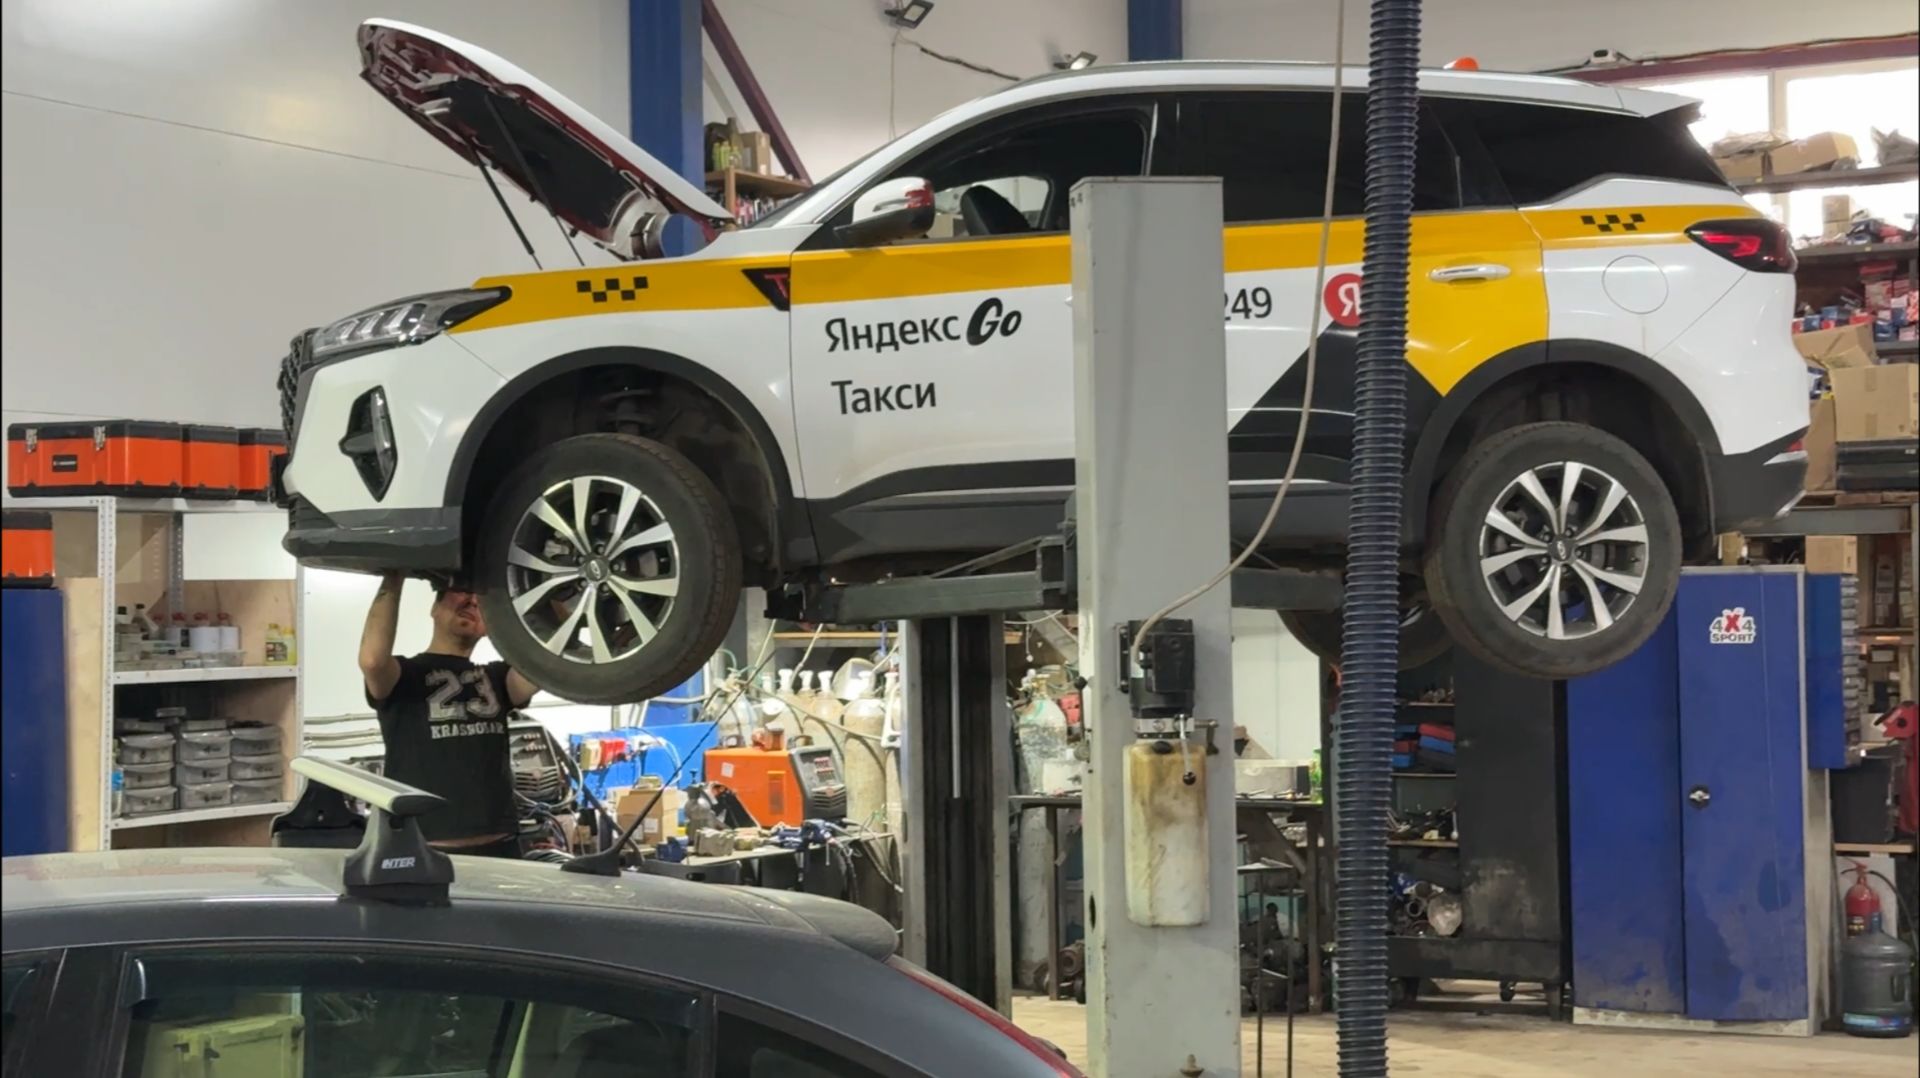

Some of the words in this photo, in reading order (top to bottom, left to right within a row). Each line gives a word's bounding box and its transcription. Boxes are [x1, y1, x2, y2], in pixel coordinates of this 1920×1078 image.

[1338, 282, 1361, 317] Я
[825, 315, 961, 353] Яндекс
[966, 297, 1022, 346] Go
[831, 380, 936, 415] Такси
[1712, 633, 1753, 642] SPORT
[425, 668, 500, 721] 23
[381, 856, 416, 869] INTER
